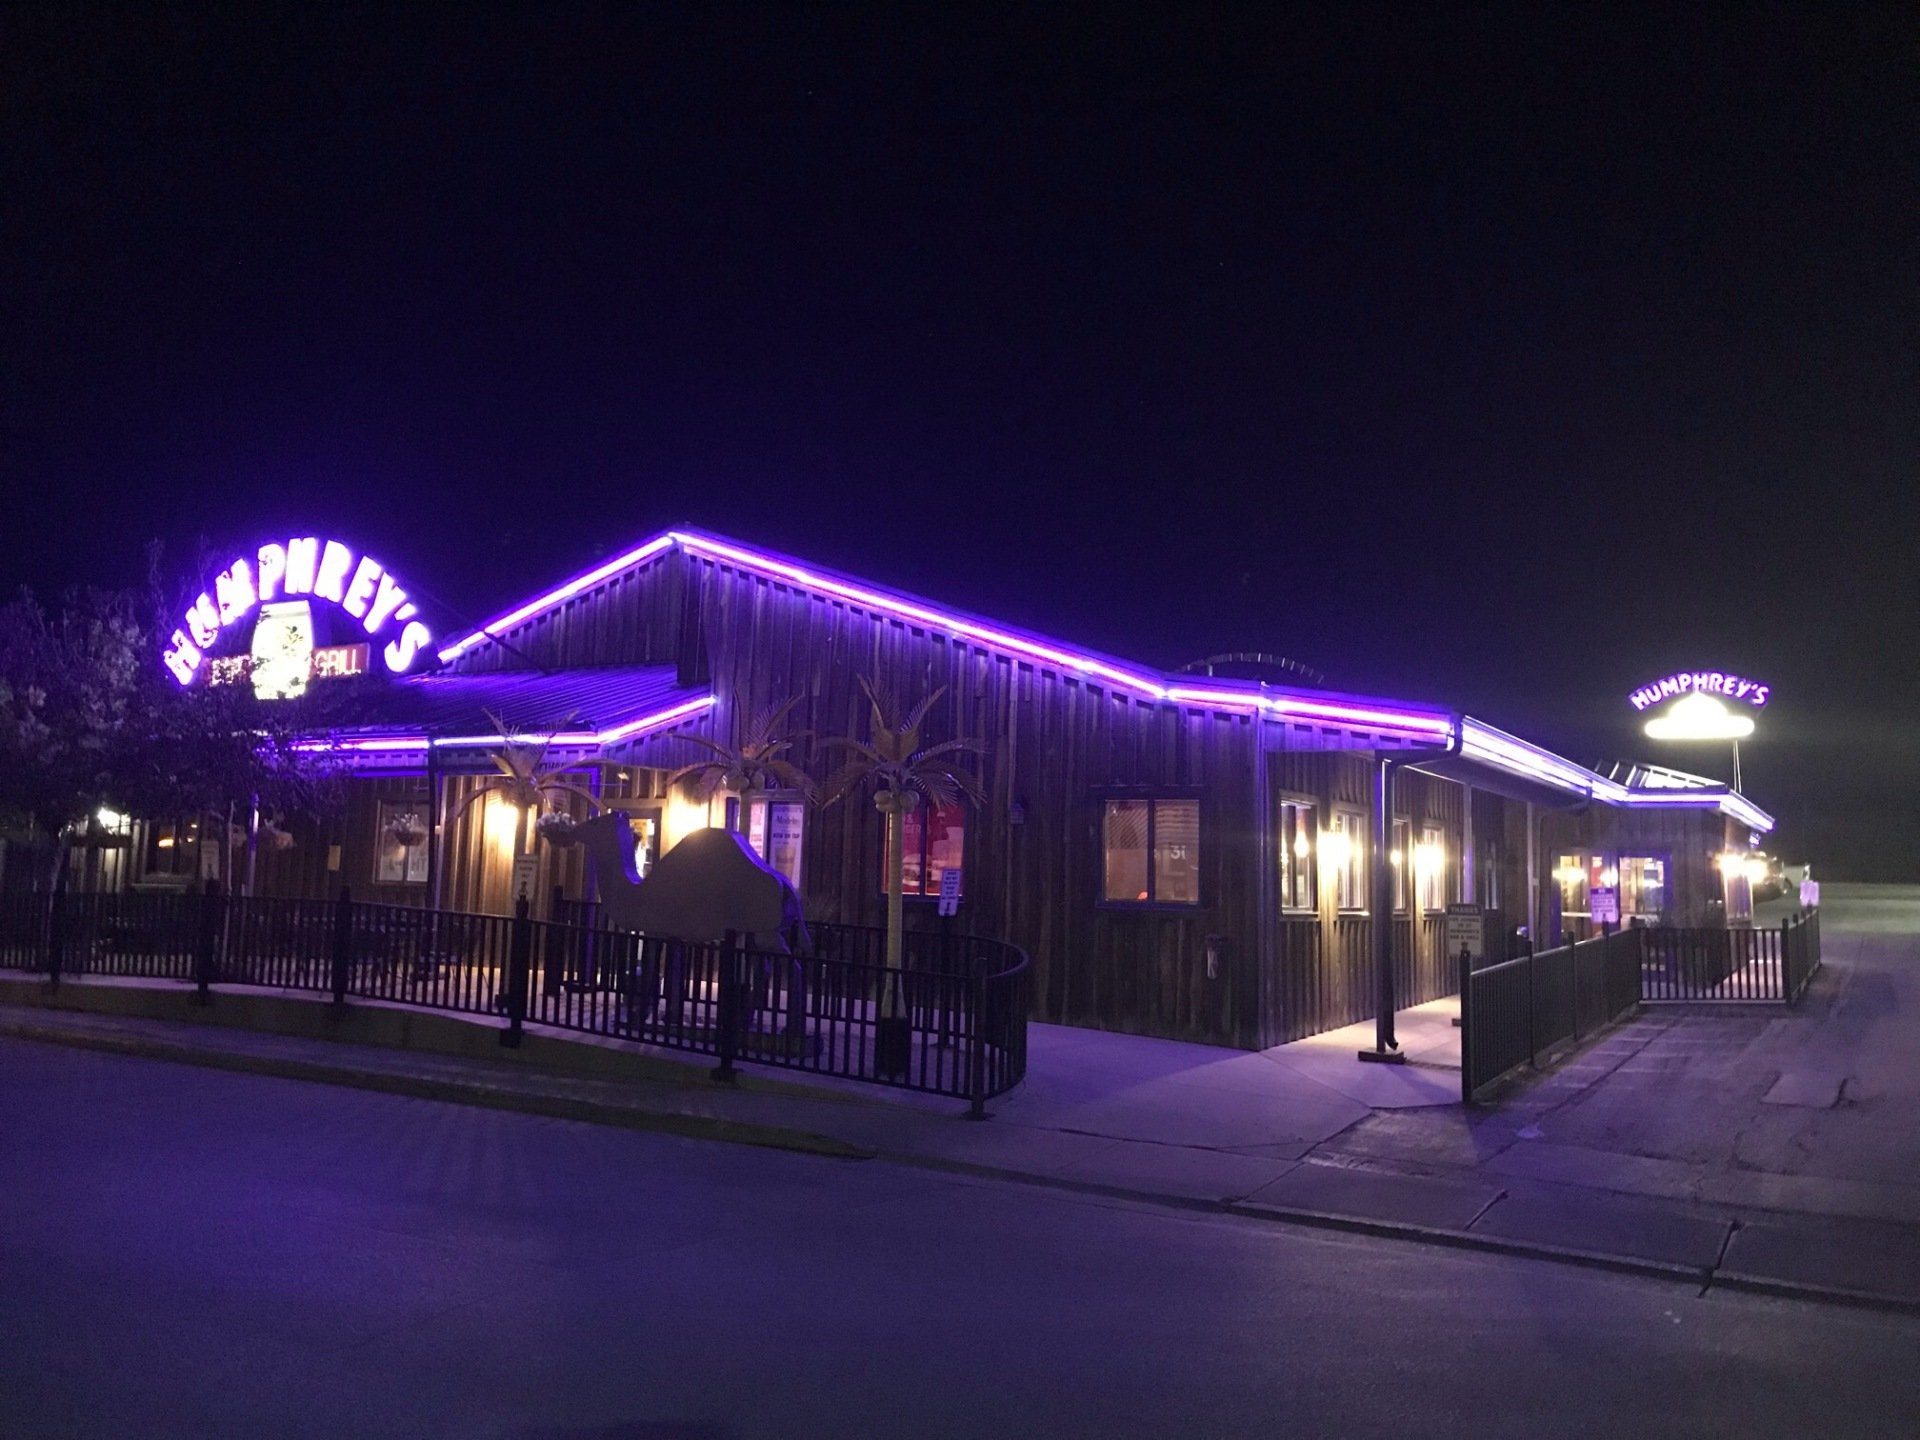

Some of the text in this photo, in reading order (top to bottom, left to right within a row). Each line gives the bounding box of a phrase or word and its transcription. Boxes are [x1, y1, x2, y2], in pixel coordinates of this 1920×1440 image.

[163, 537, 430, 686] HUMPHREY'S
[315, 648, 361, 677] GRILL
[1631, 673, 1769, 710] HUMPHREY'S
